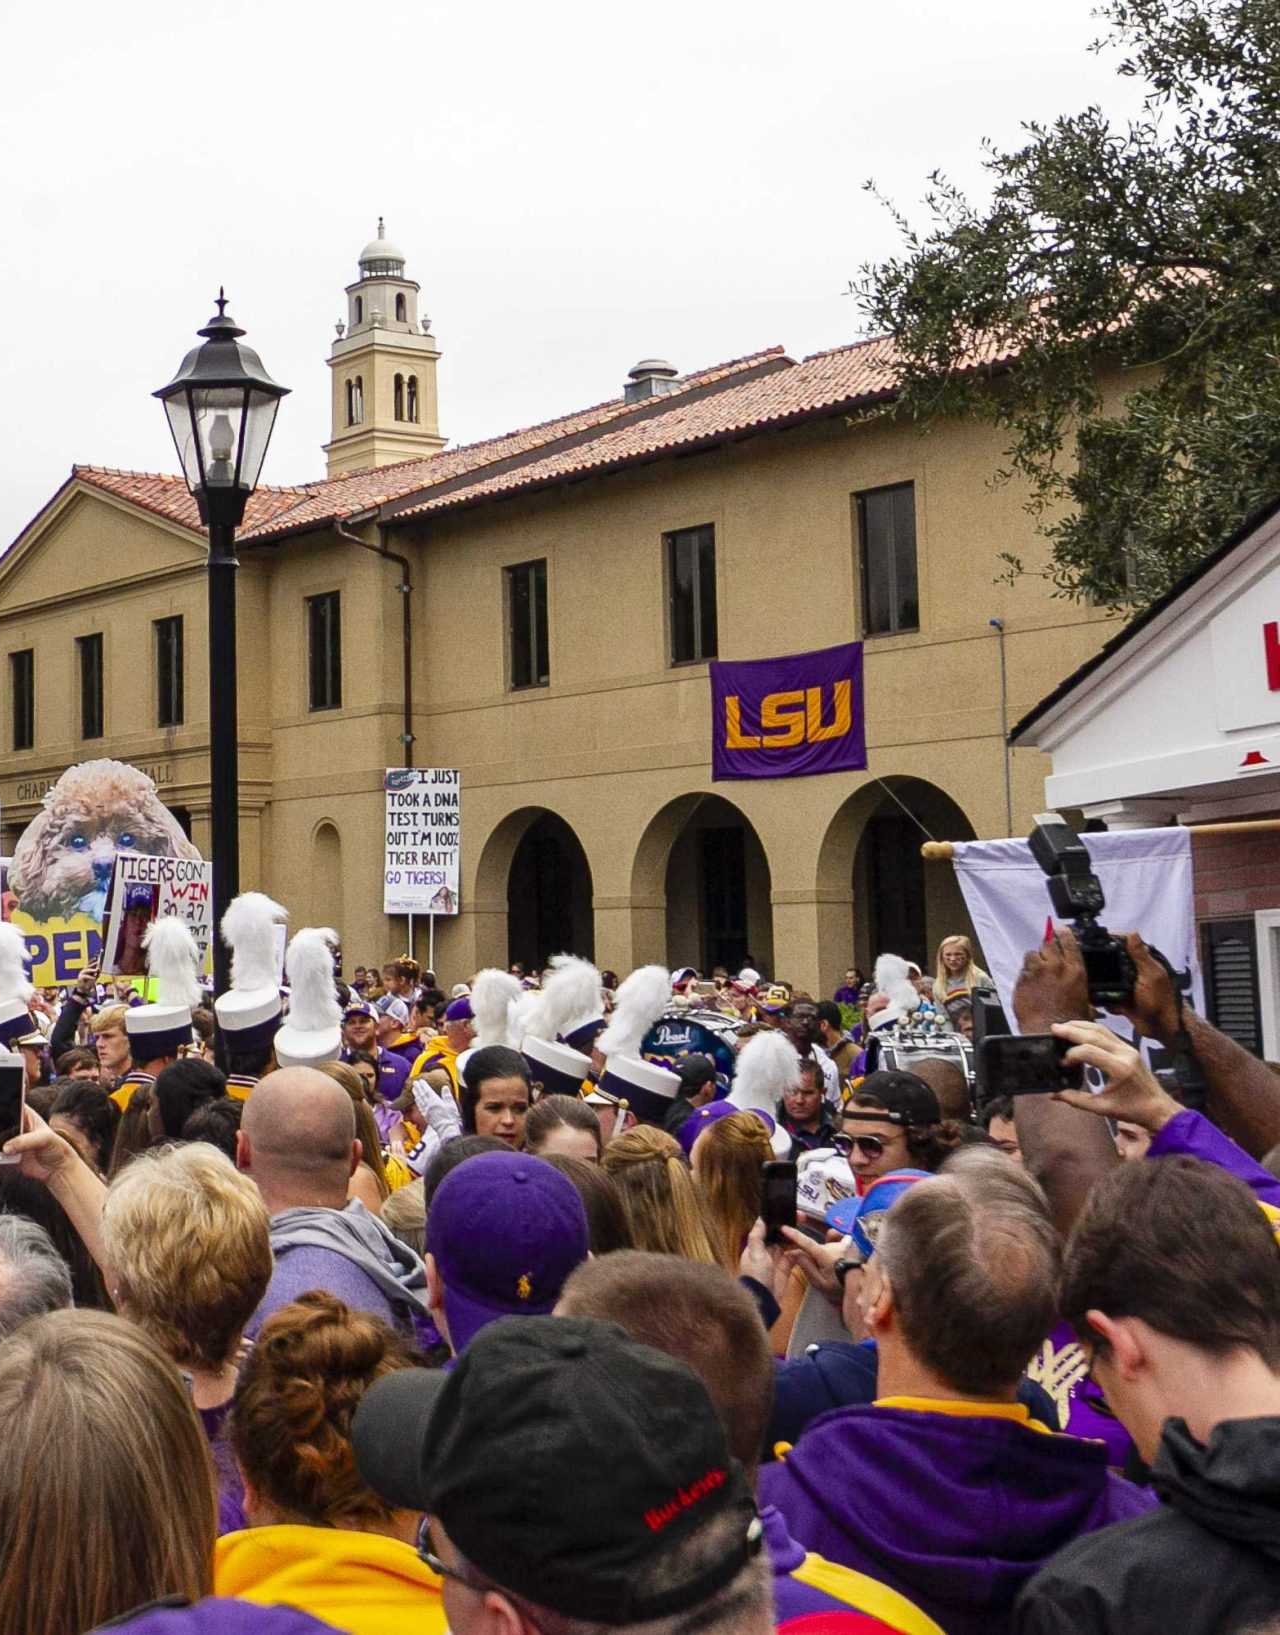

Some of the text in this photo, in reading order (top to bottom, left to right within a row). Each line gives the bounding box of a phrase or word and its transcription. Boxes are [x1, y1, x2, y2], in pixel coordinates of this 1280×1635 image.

[725, 680, 851, 748] LSU
[417, 769, 459, 784] I JUST
[388, 793, 458, 807] TOOK A DNA
[388, 812, 460, 826] TEST TURNS
[387, 830, 459, 846] OUT I'M 100%
[387, 851, 453, 866] TIGER BAIT!
[119, 857, 175, 882] TIGERS
[385, 871, 446, 885] GO TIGERS!
[170, 882, 209, 901] WIN
[653, 1025, 691, 1045] Pearl
